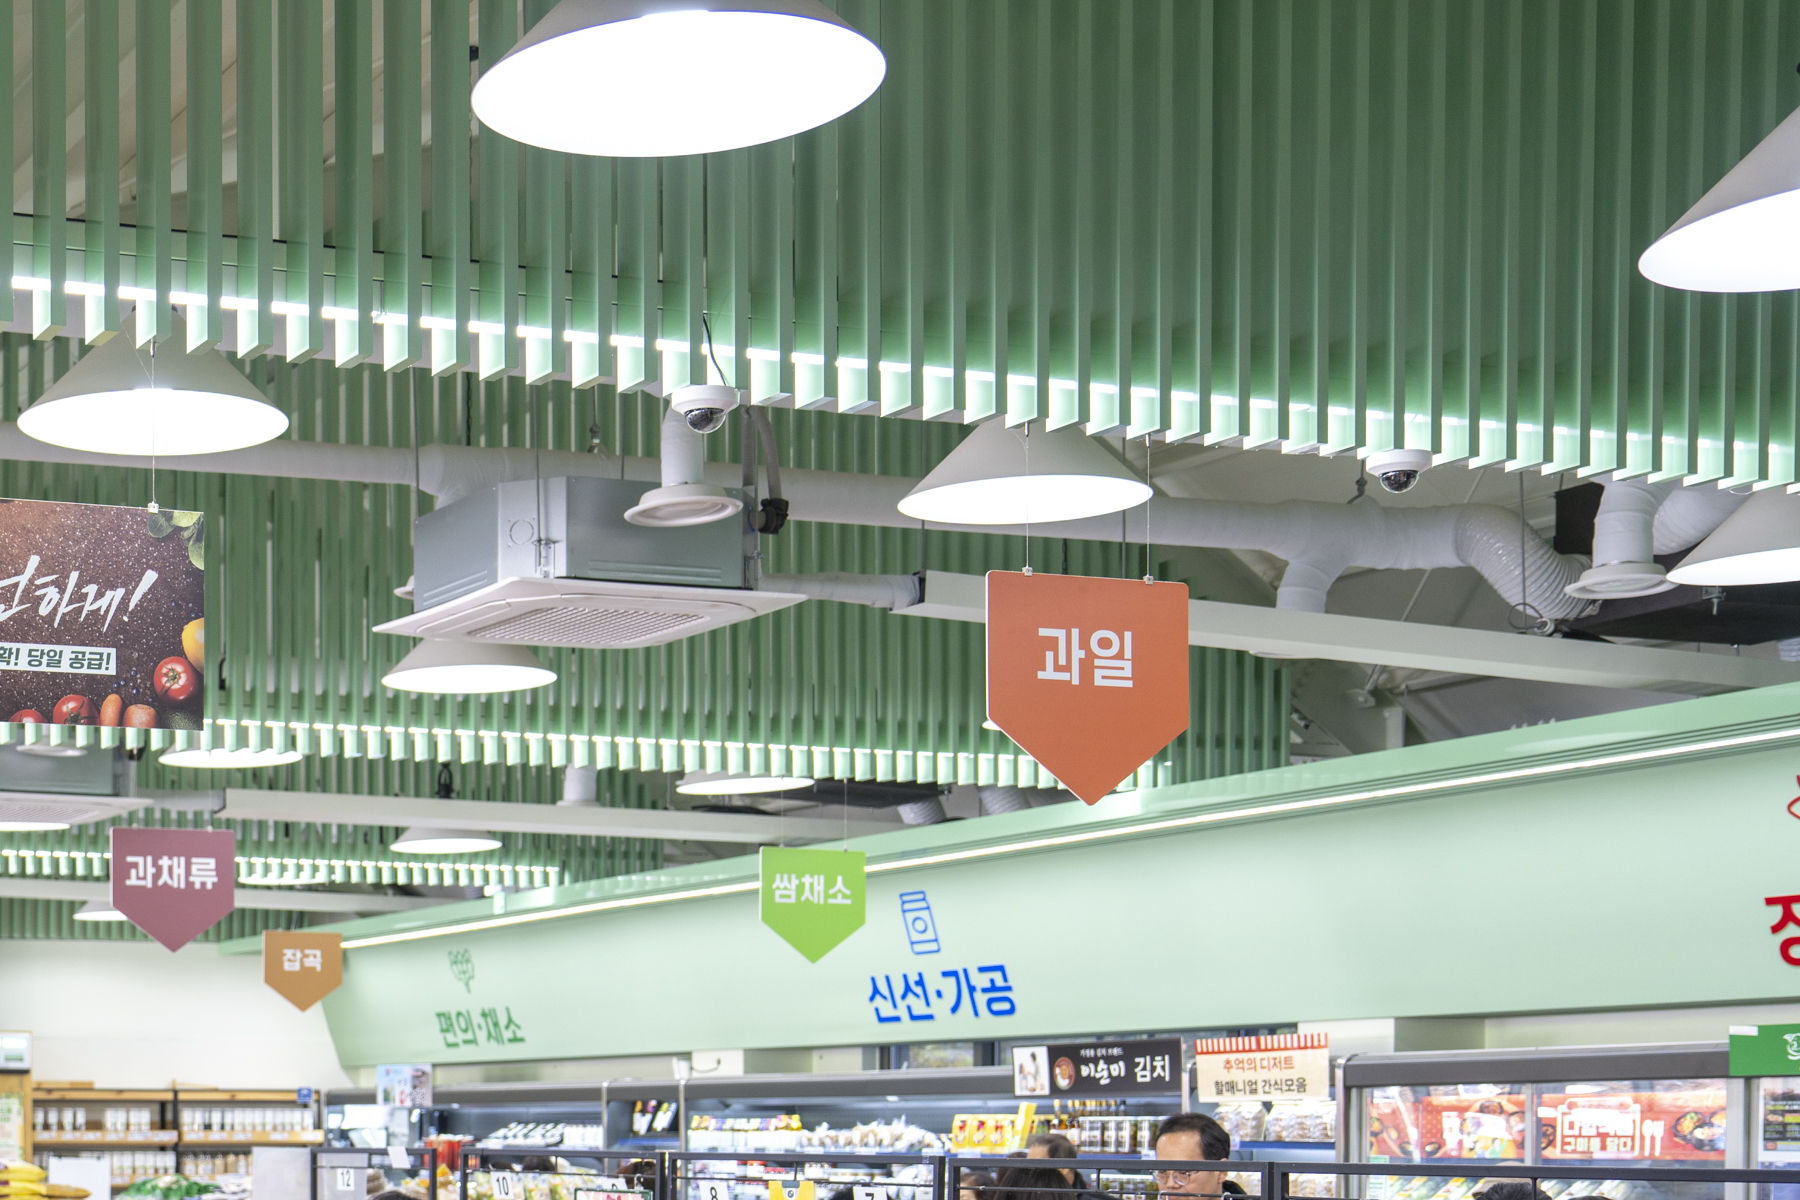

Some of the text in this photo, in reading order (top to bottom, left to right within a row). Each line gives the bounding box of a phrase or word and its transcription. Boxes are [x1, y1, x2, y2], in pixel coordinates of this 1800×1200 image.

[27, 648, 63, 668] 당일
[68, 651, 112, 671] 공급!
[1037, 627, 1134, 688] 과일
[125, 855, 219, 890] 과채류
[772, 873, 852, 905] 쌈채소
[282, 948, 323, 972] 잡곡
[869, 964, 1016, 1023] 신선·가공
[1134, 1054, 1170, 1082] 김치
[1223, 1056, 1295, 1073] 추억의 디저트
[1214, 1077, 1307, 1096] 할매니얼 간식모음
[1563, 1137, 1632, 1152] 구미를 담다
[340, 1170, 351, 1186] 12
[496, 1176, 509, 1196] 10
